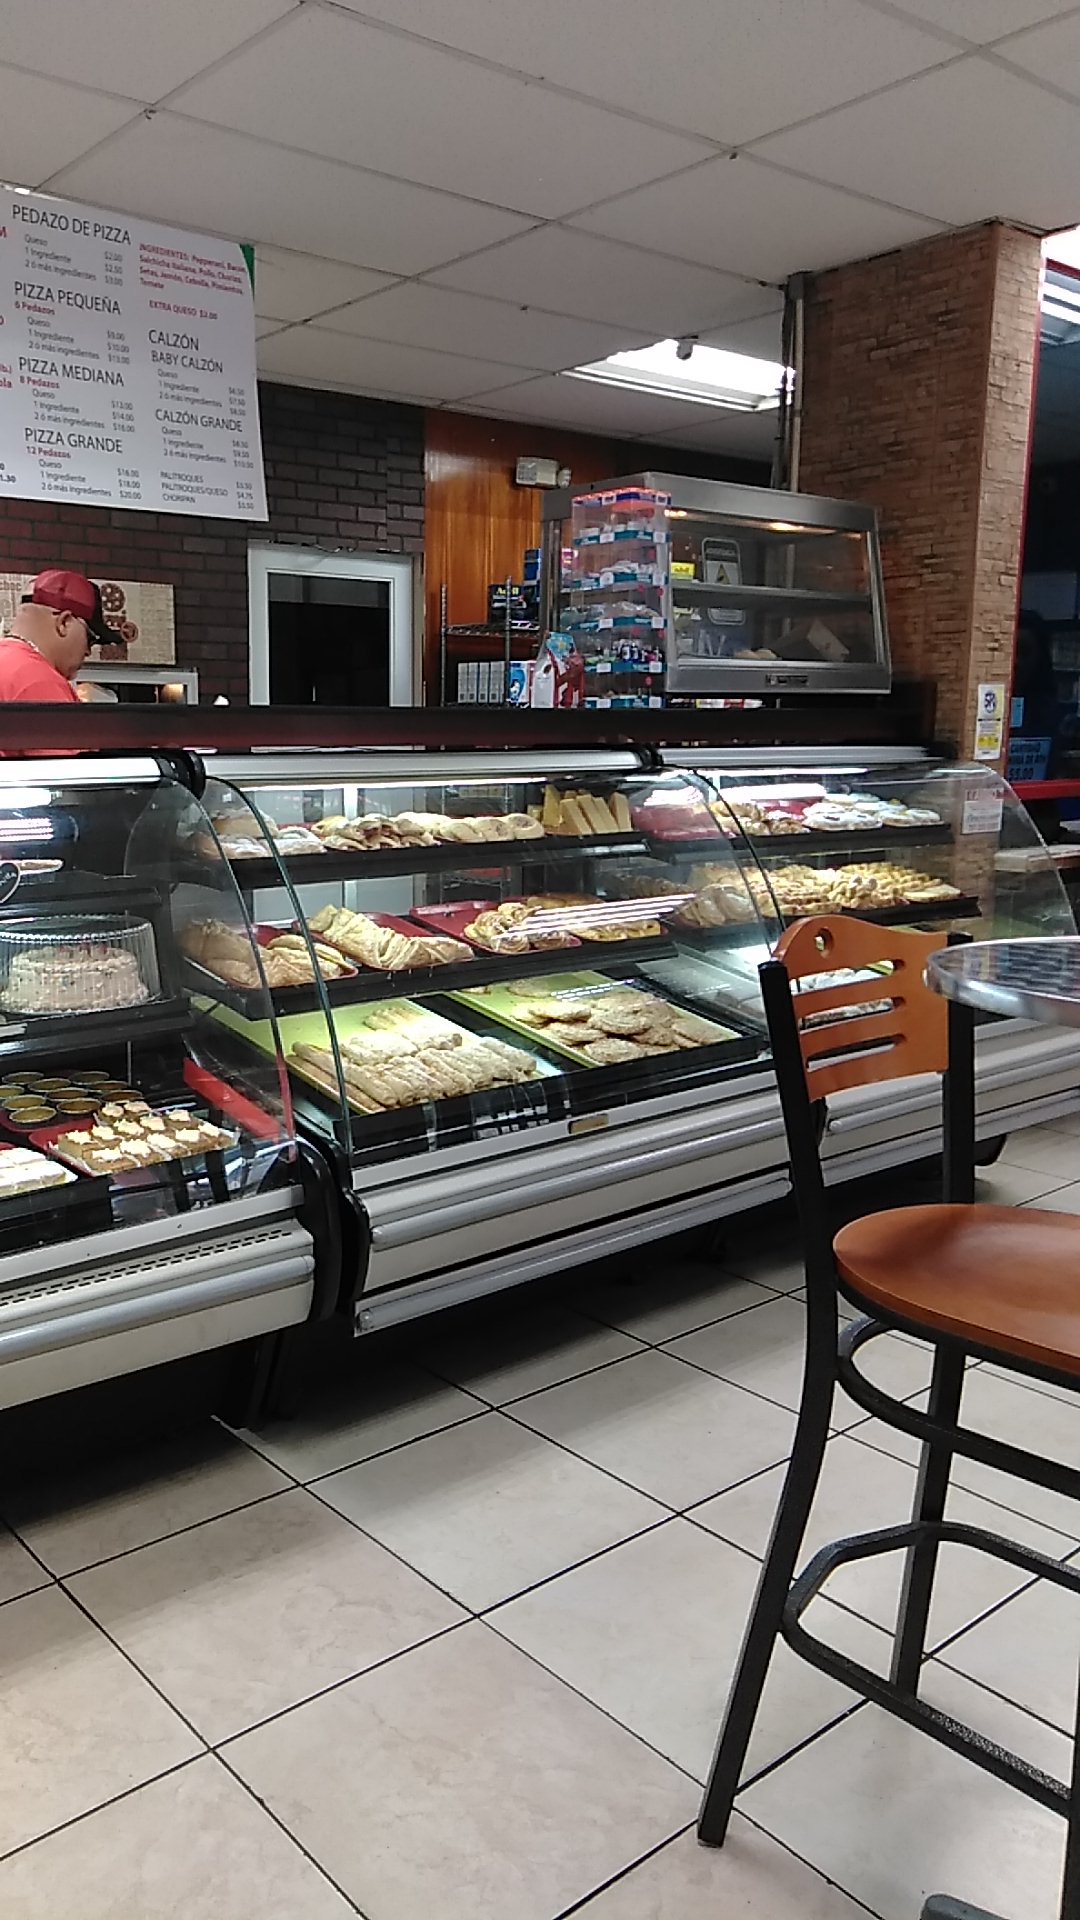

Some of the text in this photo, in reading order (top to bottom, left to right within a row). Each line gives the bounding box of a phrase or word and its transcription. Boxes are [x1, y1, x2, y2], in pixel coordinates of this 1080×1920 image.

[12, 204, 132, 246] PEDAZO DE PIZZA
[15, 281, 121, 316] PIZZA PEQUEÑA
[22, 302, 55, 315] Pedazos
[149, 300, 172, 312] EXTRA
[173, 304, 198, 317] QUESO
[27, 316, 51, 328] Queso
[28, 341, 33, 349] 2
[148, 329, 199, 351] CALZÓN
[151, 350, 223, 373] BABY CALZÓN
[19, 357, 125, 387] PIZZA MEDIANA
[27, 377, 60, 389] Pedazos
[32, 388, 55, 399] Queso
[34, 412, 39, 420] 2
[155, 409, 243, 432] CALZÓN GRANDE
[24, 427, 123, 453] PIZZA GRANDE
[27, 446, 71, 459] 12 Pedazos
[39, 459, 62, 469] Queso
[160, 471, 204, 483] PALITROQUES
[42, 482, 46, 490] 2
